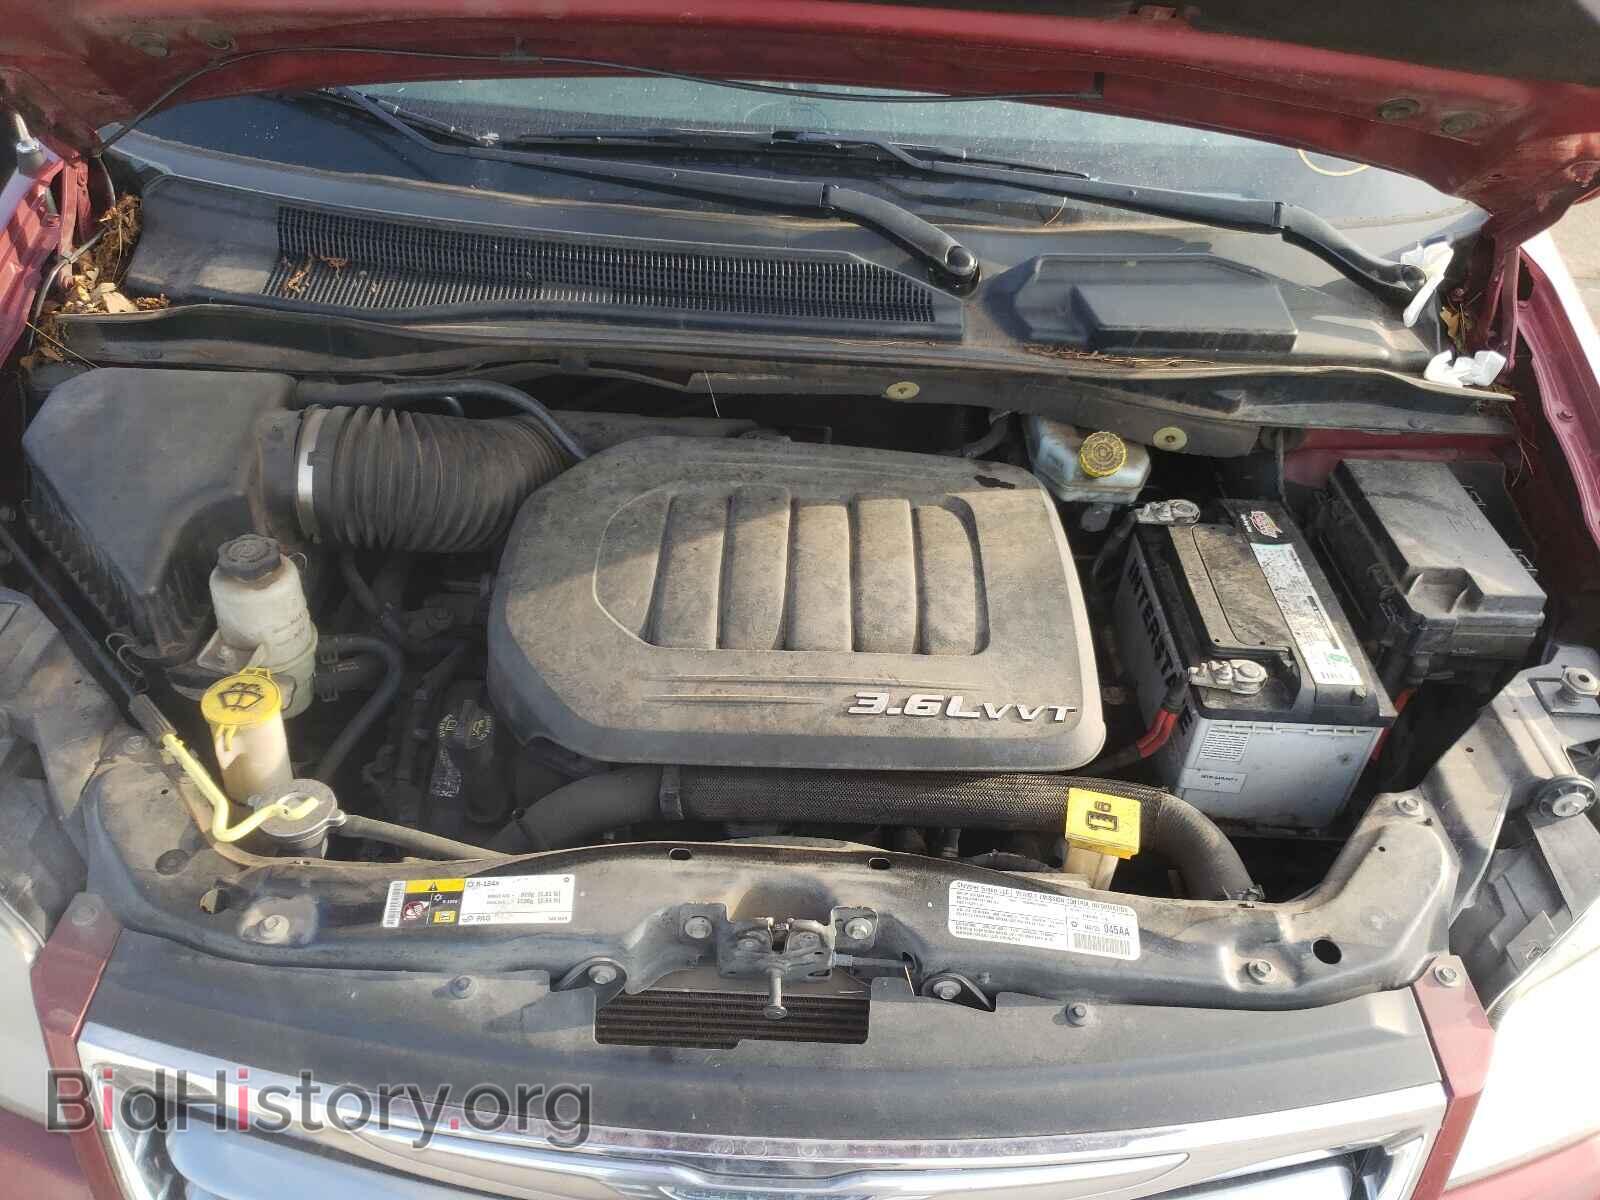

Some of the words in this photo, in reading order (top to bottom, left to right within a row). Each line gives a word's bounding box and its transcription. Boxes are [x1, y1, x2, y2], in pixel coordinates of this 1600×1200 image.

[1128, 560, 1193, 736] INTERSTAE
[848, 691, 982, 719] 3.6L
[982, 701, 1078, 723] VVT
